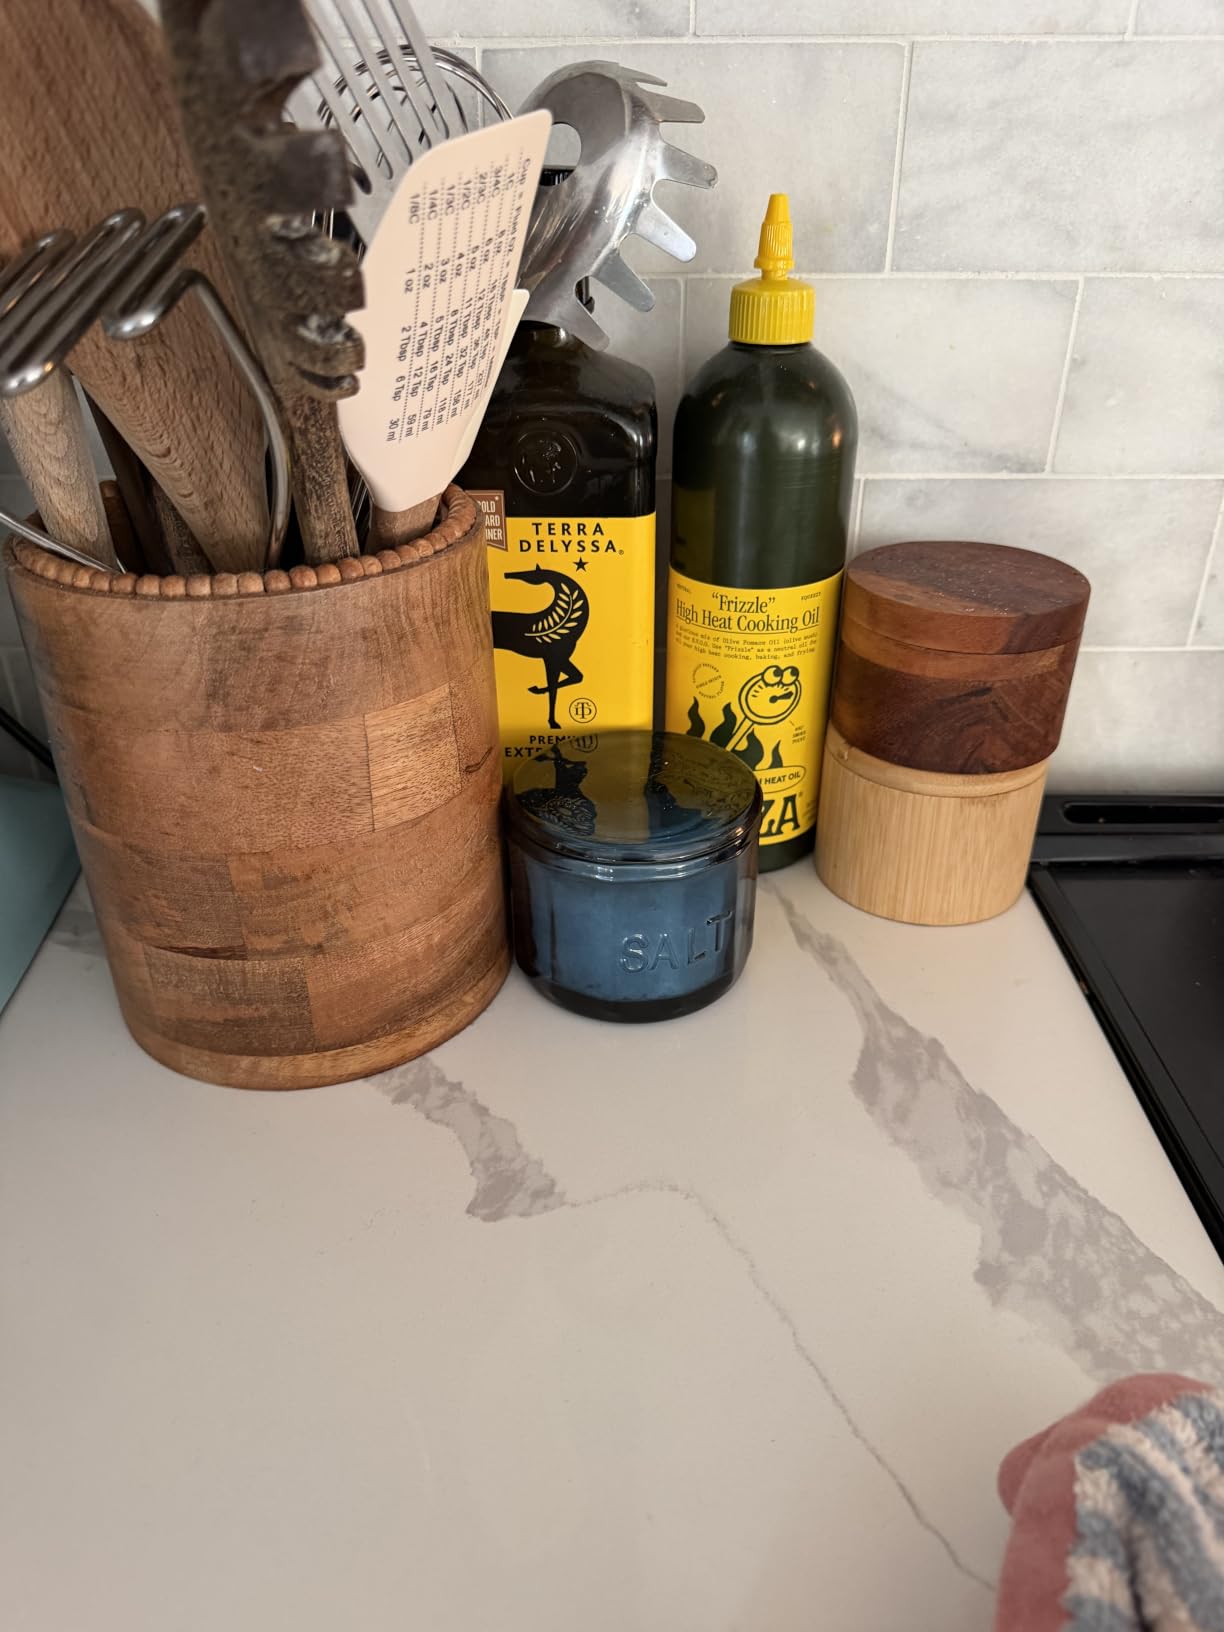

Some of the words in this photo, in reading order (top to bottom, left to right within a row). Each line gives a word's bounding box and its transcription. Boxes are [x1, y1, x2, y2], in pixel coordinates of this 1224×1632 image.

[445, 184, 456, 217] 1/3C
[461, 179, 473, 211] 1/2C
[408, 193, 421, 225] 1/8C
[427, 189, 439, 221] 1/4C
[440, 258, 450, 267] 3
[456, 252, 465, 260] 4
[405, 267, 416, 275] 1
[424, 263, 434, 271] 2
[454, 263, 463, 279] oz
[468, 256, 478, 272] oz
[422, 274, 432, 290] oz
[439, 269, 448, 285] oz
[403, 279, 414, 294] oz
[464, 297, 473, 310] 11
[473, 303, 484, 330] Tbsp
[401, 324, 412, 334] 2
[419, 321, 429, 329] 4
[460, 310, 472, 339] Tbsp
[430, 325, 444, 353] Tbsp
[446, 319, 459, 346] Tbsp
[396, 335, 411, 362] Tbsp
[415, 330, 428, 358] Tbsp
[444, 352, 454, 367] 24
[459, 345, 469, 361] 32
[469, 351, 479, 370] Tsp
[412, 365, 423, 379] 12
[429, 360, 439, 374] 16
[456, 359, 467, 379] Tsp
[395, 375, 406, 383] 6
[426, 373, 438, 393] Tsp
[441, 366, 453, 386] Tsp
[391, 383, 405, 402] Tsp
[409, 379, 422, 398] Tsp
[437, 397, 448, 414] 118
[406, 413, 417, 426] 59
[422, 407, 433, 420] 79
[435, 413, 444, 426] ml
[388, 416, 400, 430] 30
[421, 419, 429, 432] ml
[386, 430, 397, 442] ml
[405, 425, 414, 438] ml
[485, 514, 501, 527] ARD
[532, 522, 604, 536] TERRA
[519, 539, 617, 553] DELYSSA
[676, 598, 698, 625] High
[702, 609, 733, 631] Heat
[737, 614, 798, 634] Cooking
[802, 606, 820, 627] Oil
[722, 636, 740, 645] Olive
[529, 735, 576, 745] PREM
[504, 747, 543, 758] EXT
[764, 774, 787, 785] HEAT
[788, 771, 801, 781] OIL
[619, 909, 733, 974] SALT
